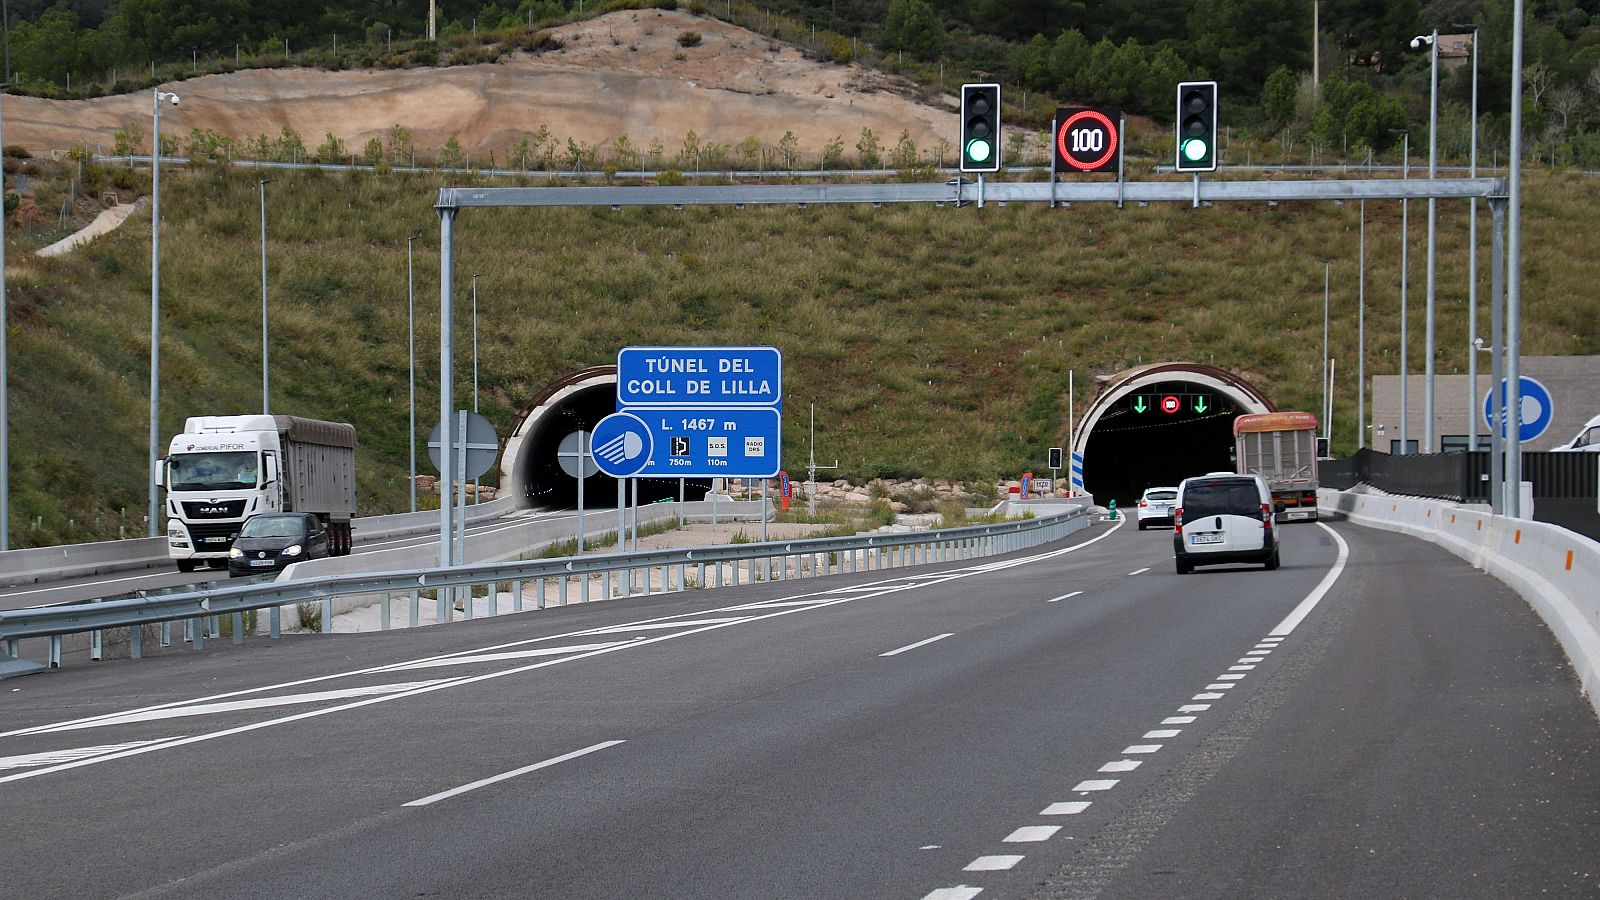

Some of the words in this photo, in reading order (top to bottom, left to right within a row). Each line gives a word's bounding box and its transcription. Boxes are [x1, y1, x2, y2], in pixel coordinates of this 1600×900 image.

[1071, 128, 1103, 152] 100
[645, 356, 708, 373] TÚNEL
[718, 358, 754, 373] DEL
[627, 380, 676, 394] COLL
[686, 380, 711, 394] DE
[721, 380, 771, 394] LILLA
[661, 418, 673, 431] L.
[681, 418, 715, 431] 1467
[723, 421, 737, 431] m
